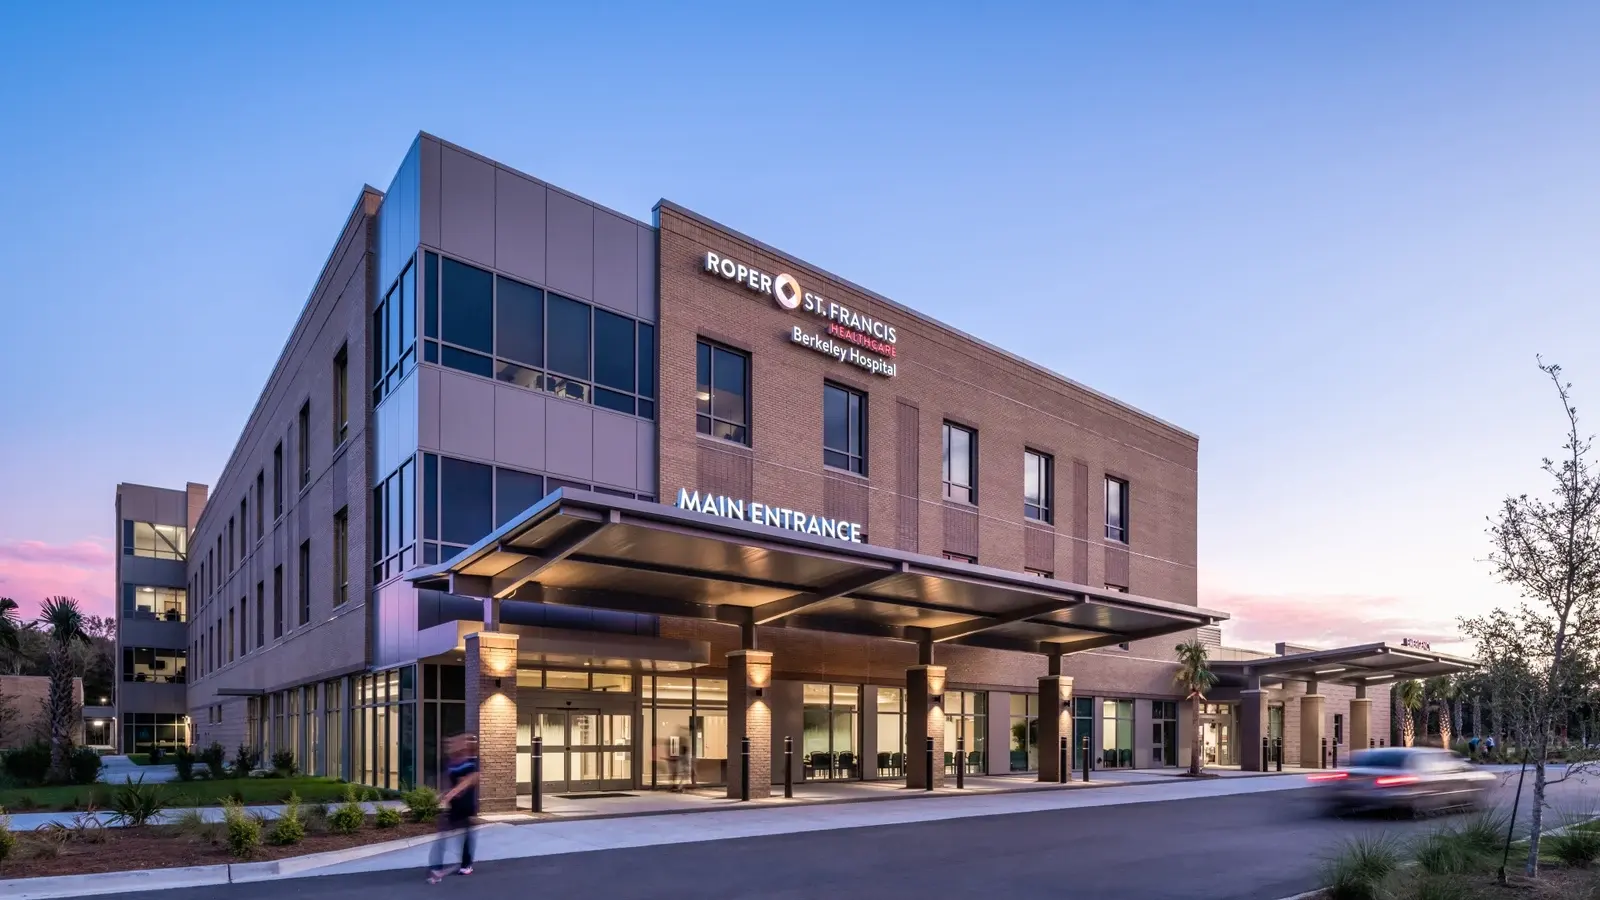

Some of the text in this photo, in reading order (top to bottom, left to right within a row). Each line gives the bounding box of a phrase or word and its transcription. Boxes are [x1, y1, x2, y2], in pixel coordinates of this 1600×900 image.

[706, 251, 897, 344] ROPER ST. FRANCIS
[792, 326, 897, 377] Berkeley Hospital
[830, 323, 897, 357] HEALTHCARE
[679, 487, 862, 544] MAIN ENTRANCE
